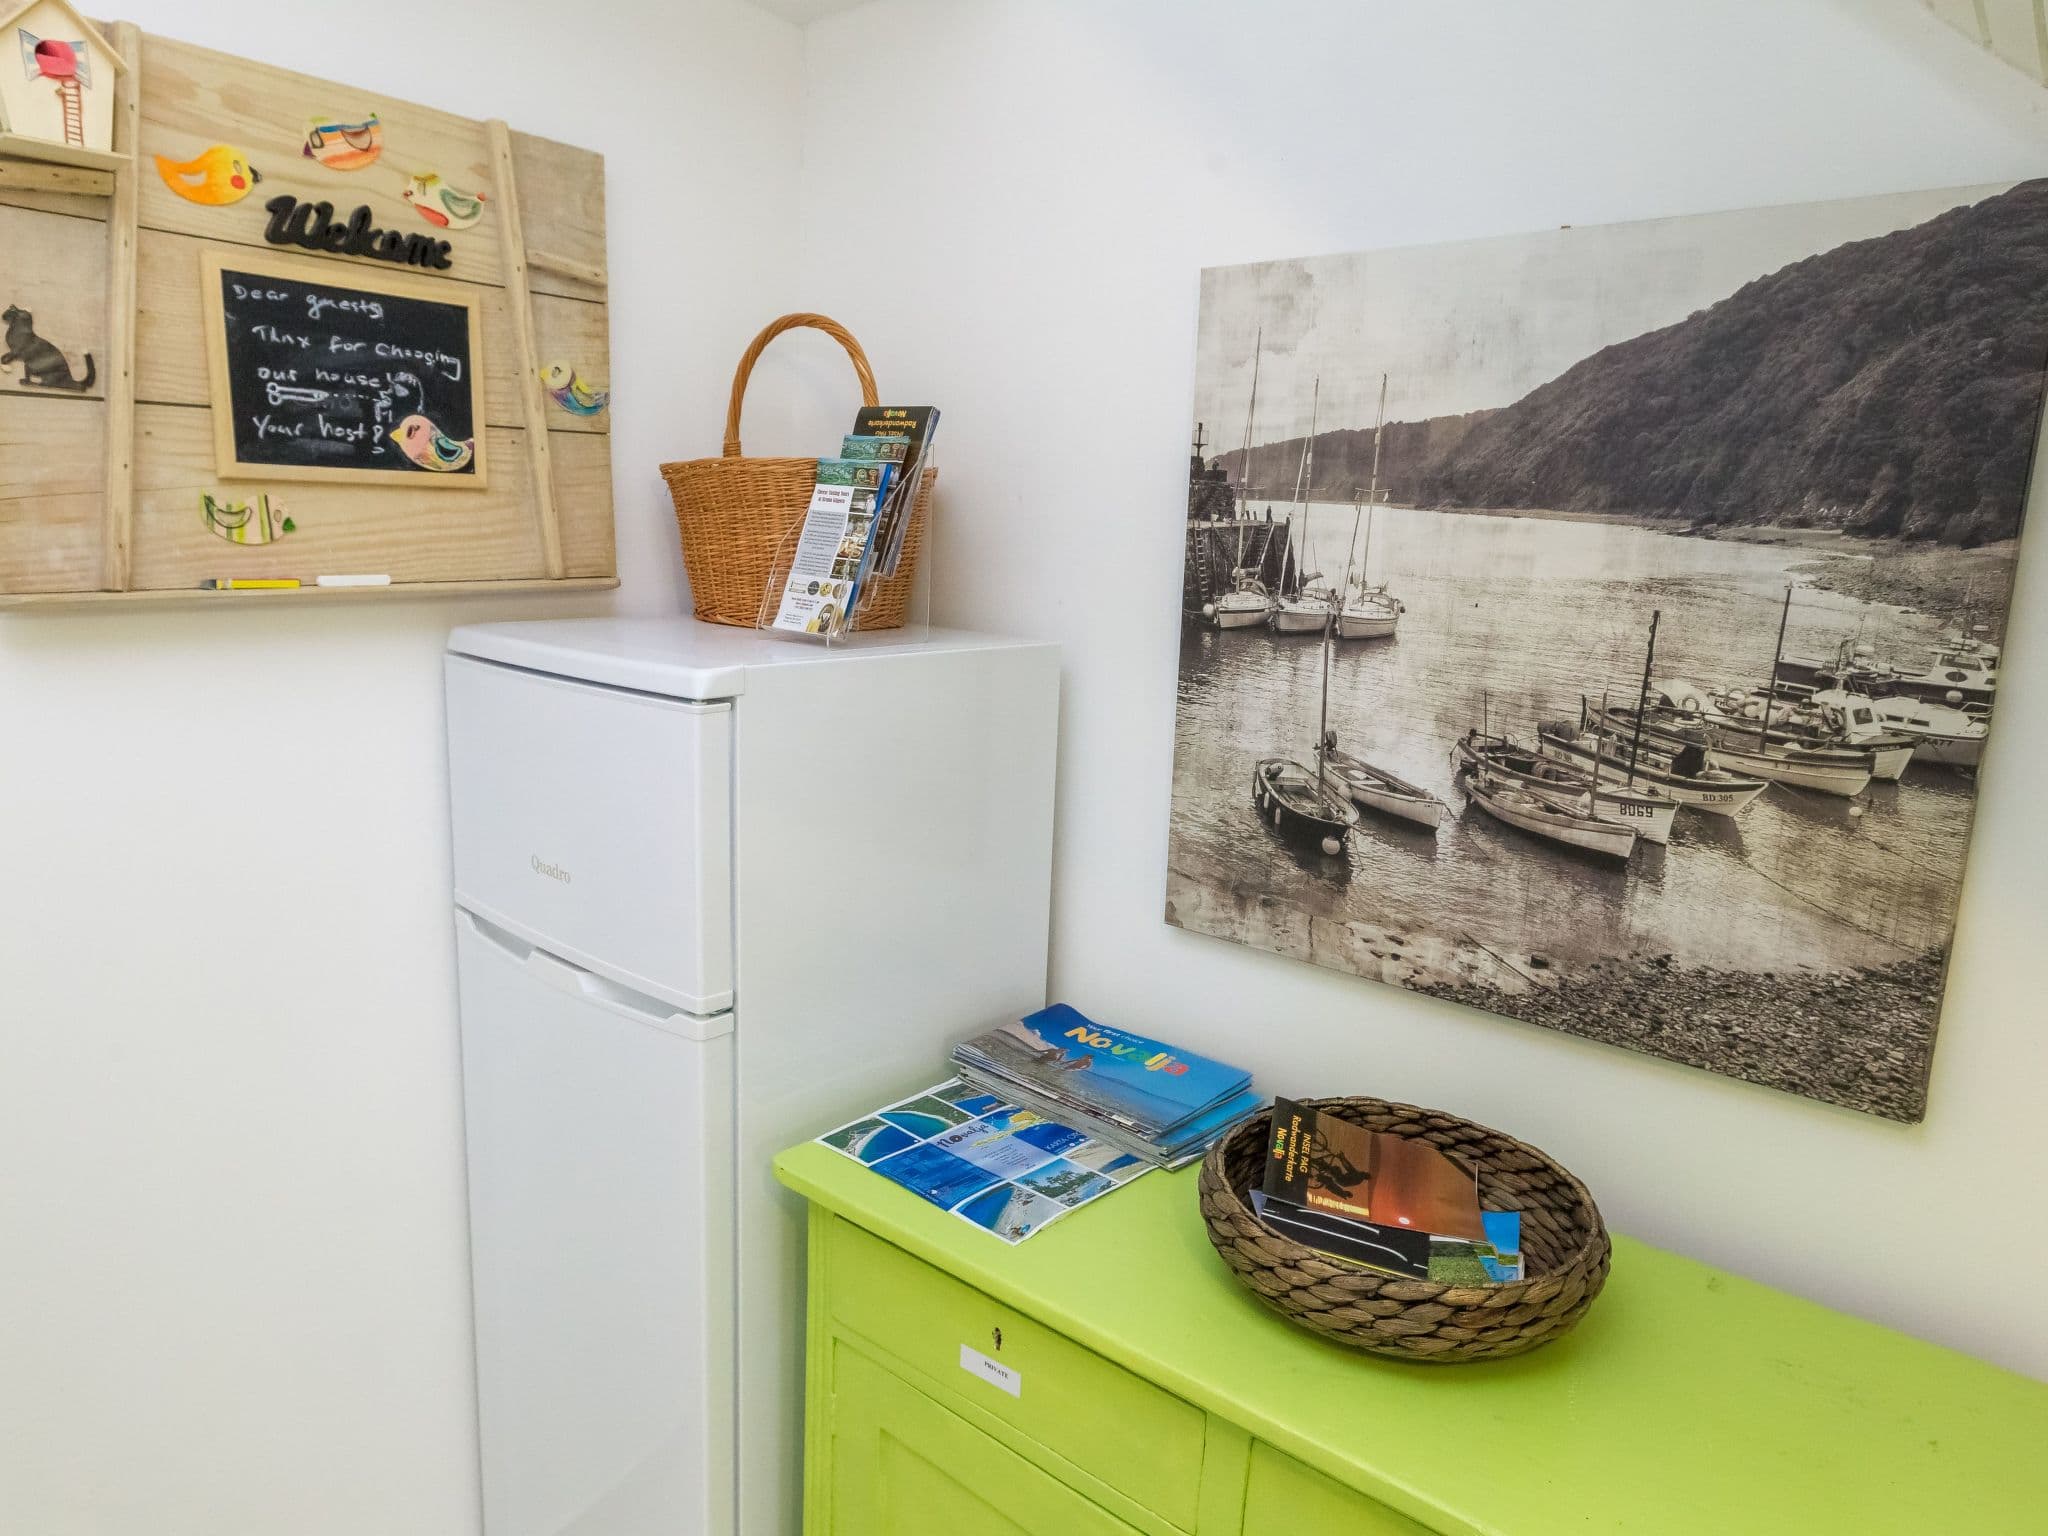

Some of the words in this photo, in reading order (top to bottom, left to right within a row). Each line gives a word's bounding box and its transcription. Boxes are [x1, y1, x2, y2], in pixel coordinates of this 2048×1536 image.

[232, 284, 289, 300] Dear
[329, 336, 367, 353] for
[531, 854, 571, 884] Quadro
[1285, 1114, 1302, 1182] Radwanderkarte
[1302, 1132, 1311, 1155] INSEL
[1300, 1156, 1309, 1173] PAG
[984, 1361, 1009, 1380] PRIVATE
